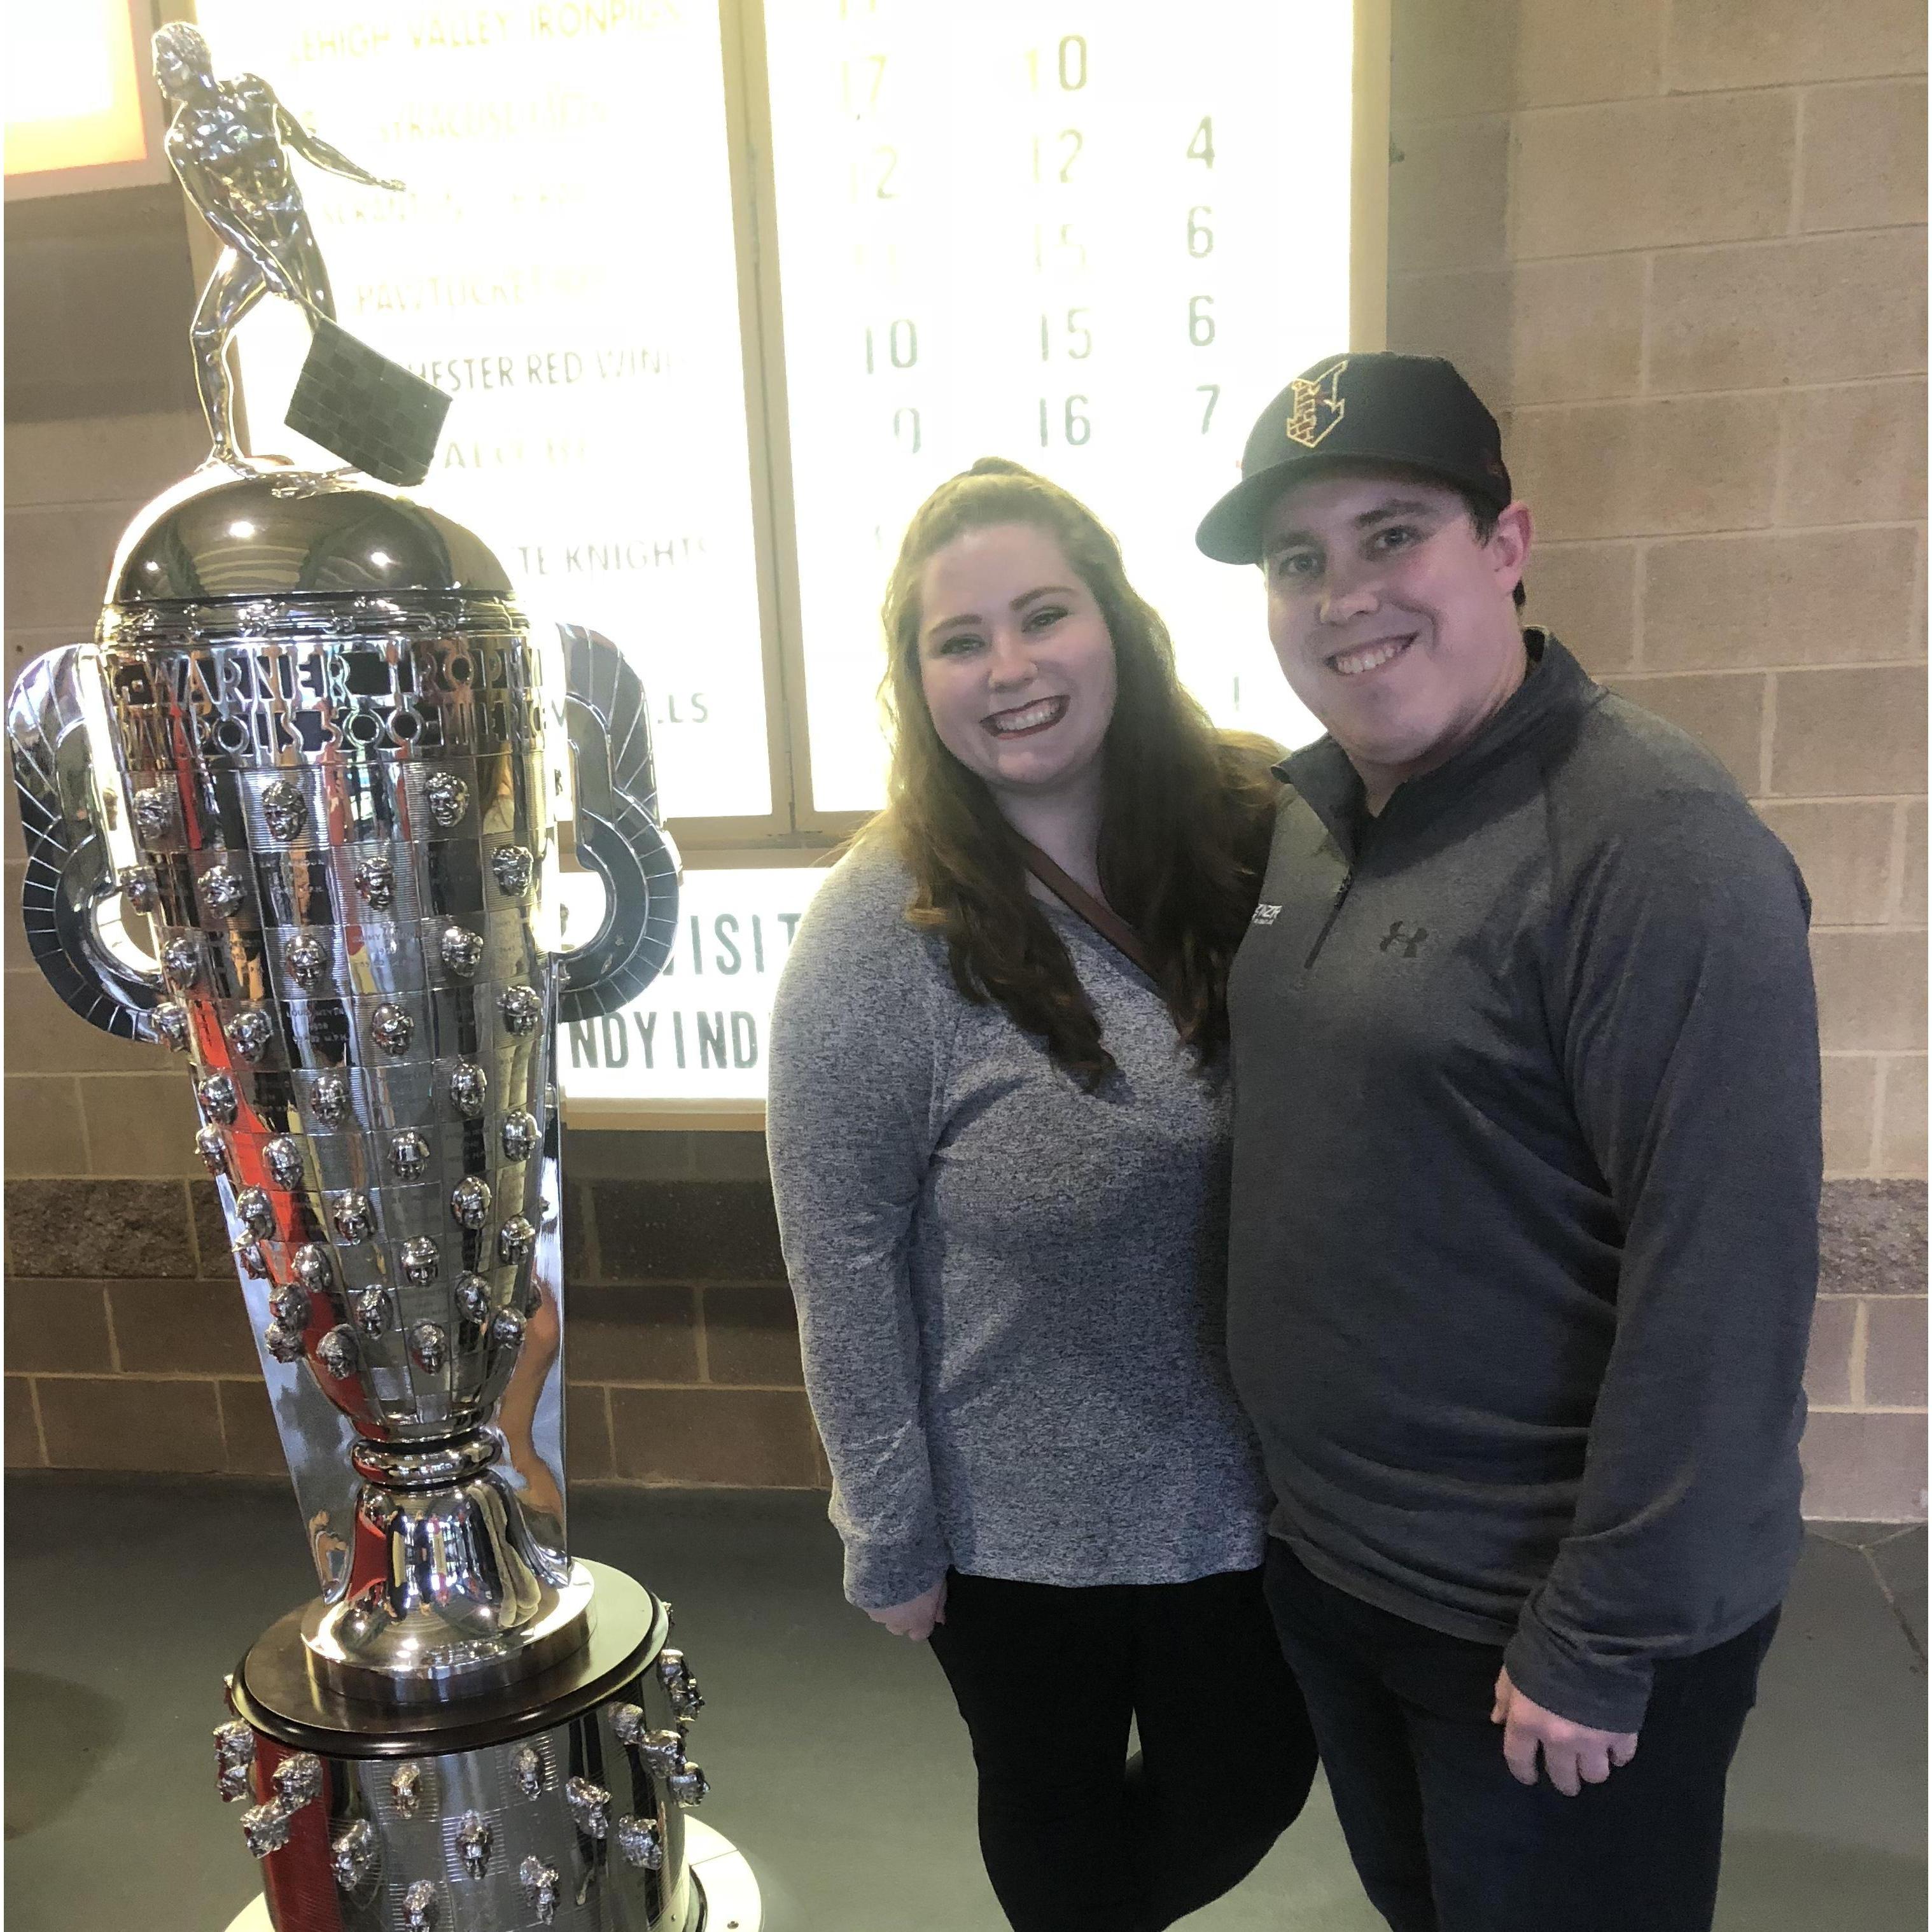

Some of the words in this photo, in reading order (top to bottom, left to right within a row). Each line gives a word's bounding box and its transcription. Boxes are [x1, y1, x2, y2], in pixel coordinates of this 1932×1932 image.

[1026, 34, 1089, 92] 10
[1031, 129, 1084, 183] 12
[1186, 116, 1215, 169] 4
[1187, 206, 1215, 258] 6
[865, 319, 918, 374] 10
[1042, 308, 1093, 361] 15
[1188, 295, 1215, 346] 6
[526, 351, 584, 385] RED
[1039, 394, 1091, 447] 16
[1196, 384, 1221, 434] 7
[663, 913, 802, 976] ISIT
[568, 1011, 759, 1069] NDYIND
